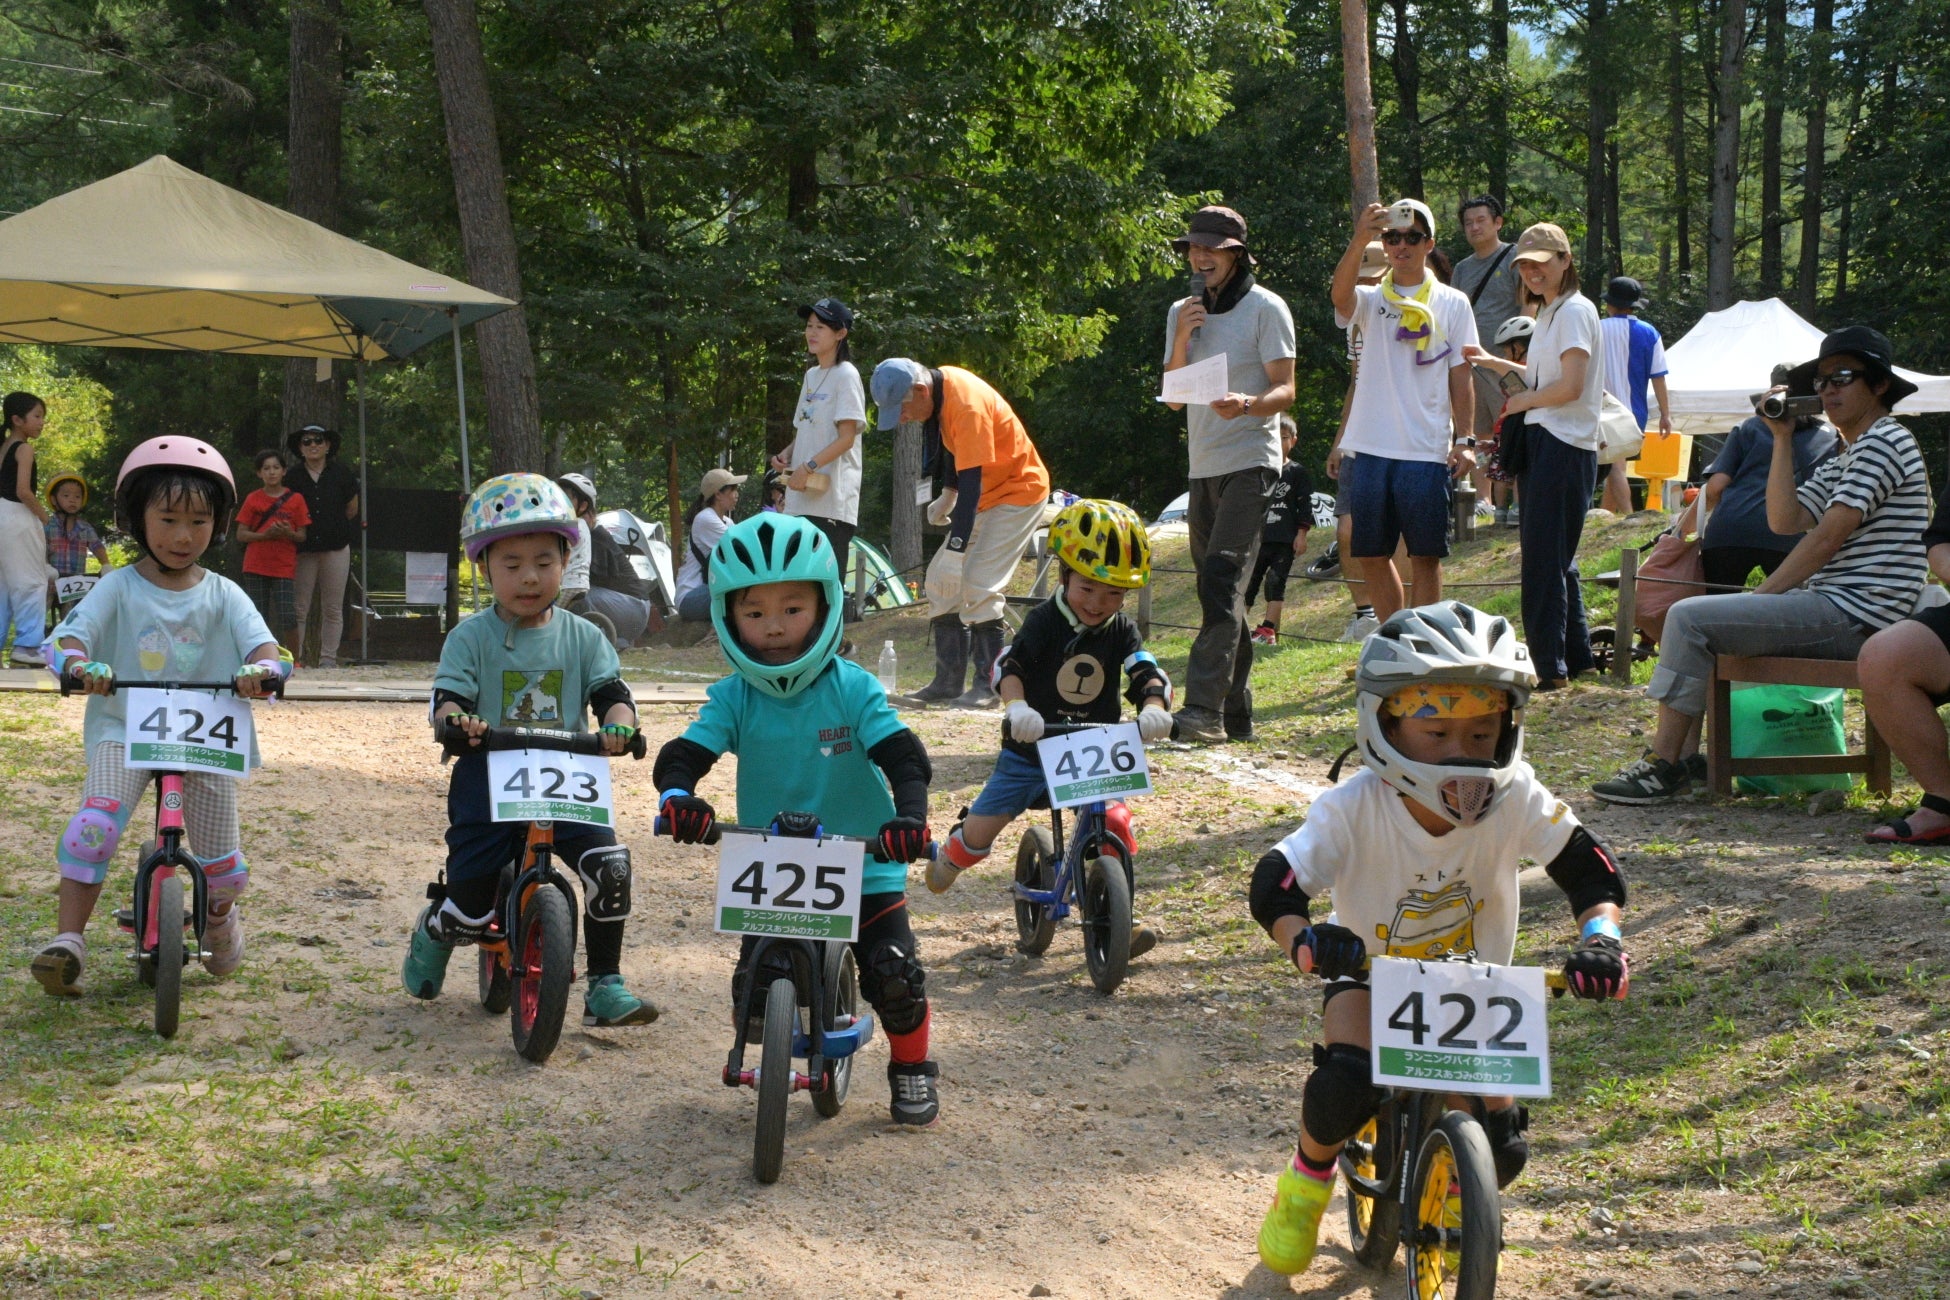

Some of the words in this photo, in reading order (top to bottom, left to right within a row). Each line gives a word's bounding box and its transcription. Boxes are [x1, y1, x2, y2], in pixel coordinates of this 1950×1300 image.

[62, 581, 96, 594] 427
[139, 706, 239, 749] 424
[818, 726, 851, 742] HEART
[833, 741, 853, 756] KIDS
[1054, 740, 1136, 780] 426
[503, 767, 599, 803] 423
[731, 861, 846, 911] 425
[742, 910, 832, 924] ランニングバイクレース
[741, 922, 831, 936] アルプスあづみのカップ
[1388, 991, 1527, 1051] 422
[1404, 1051, 1513, 1068] ランニングバイクレース
[1404, 1065, 1512, 1083] アルプスあづみのカップ
